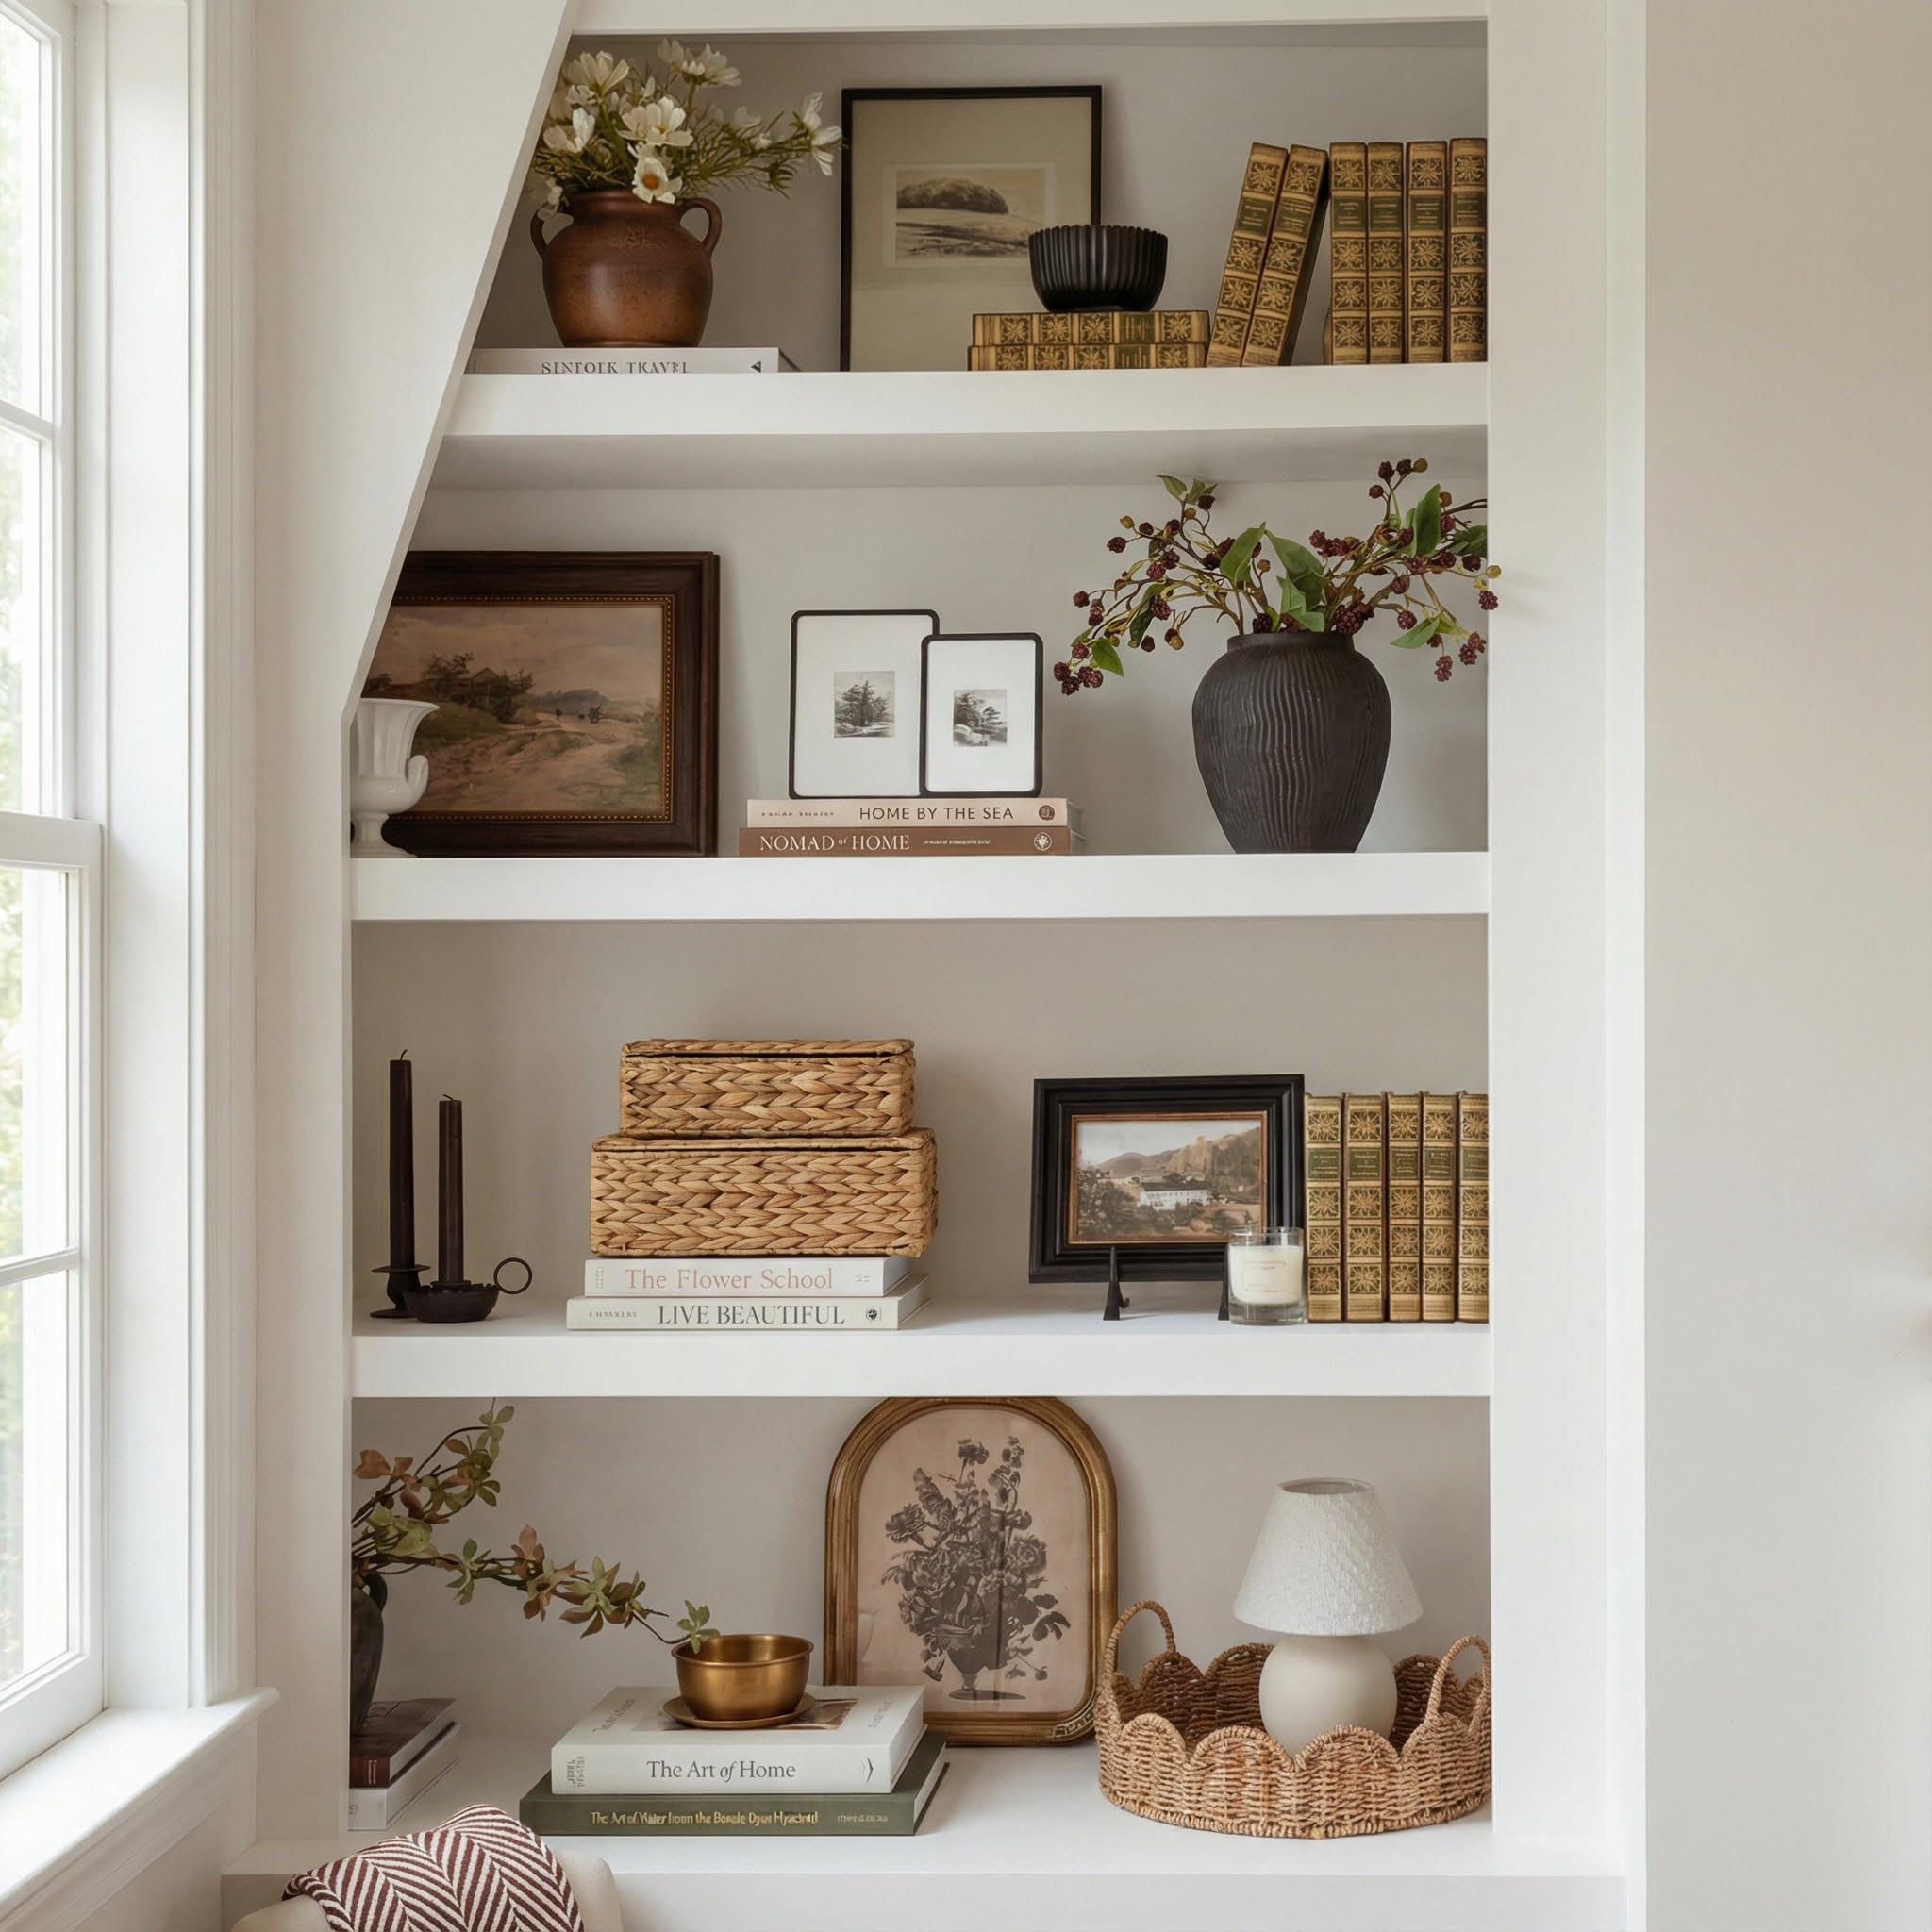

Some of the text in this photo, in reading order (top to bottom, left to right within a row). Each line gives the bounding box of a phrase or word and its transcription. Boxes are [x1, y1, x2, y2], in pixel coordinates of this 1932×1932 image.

[859, 807, 1014, 821] HOME BY THE SEA
[759, 834, 835, 851] NOMAD
[852, 834, 910, 851] HOME
[625, 1268, 667, 1290] The
[677, 1268, 752, 1290] Flower
[760, 1267, 833, 1290] School
[658, 1305, 710, 1324] LIVE
[717, 1305, 845, 1324] BEAUTIFUL
[646, 1760, 796, 1783] The Art of Home
[694, 1810, 711, 1824] the
